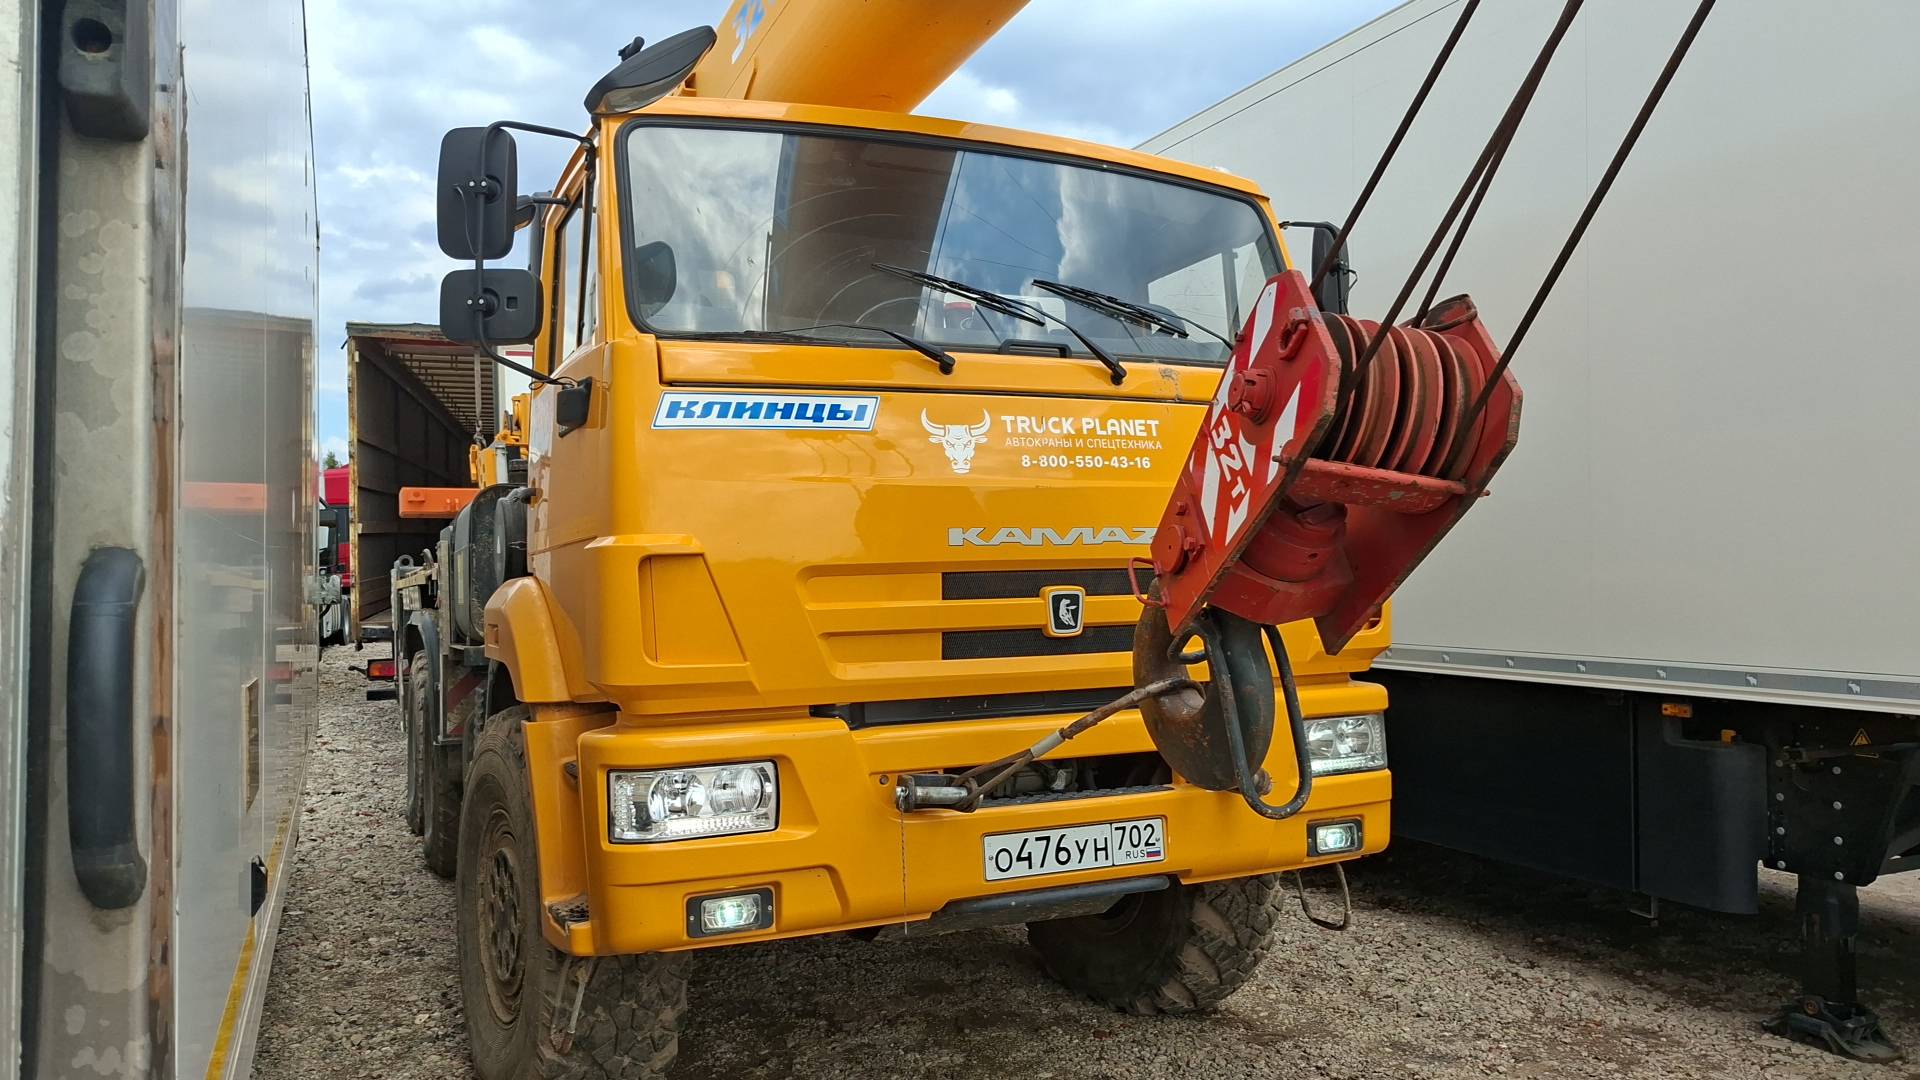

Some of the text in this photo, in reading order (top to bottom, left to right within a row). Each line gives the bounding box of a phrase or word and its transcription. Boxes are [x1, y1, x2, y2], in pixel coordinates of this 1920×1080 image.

[665, 400, 869, 423] КЛИНЦЫ
[1001, 415, 1160, 437] TRUCK PLANET
[1005, 437, 1163, 450] АВТОКРАНЫ И СПЕЦТЕХНИКА
[1021, 455, 1151, 469] 8-800-550-43-16
[947, 527, 1157, 546] KAMAZ
[1114, 823, 1156, 850] 702
[1125, 850, 1146, 860] RUS
